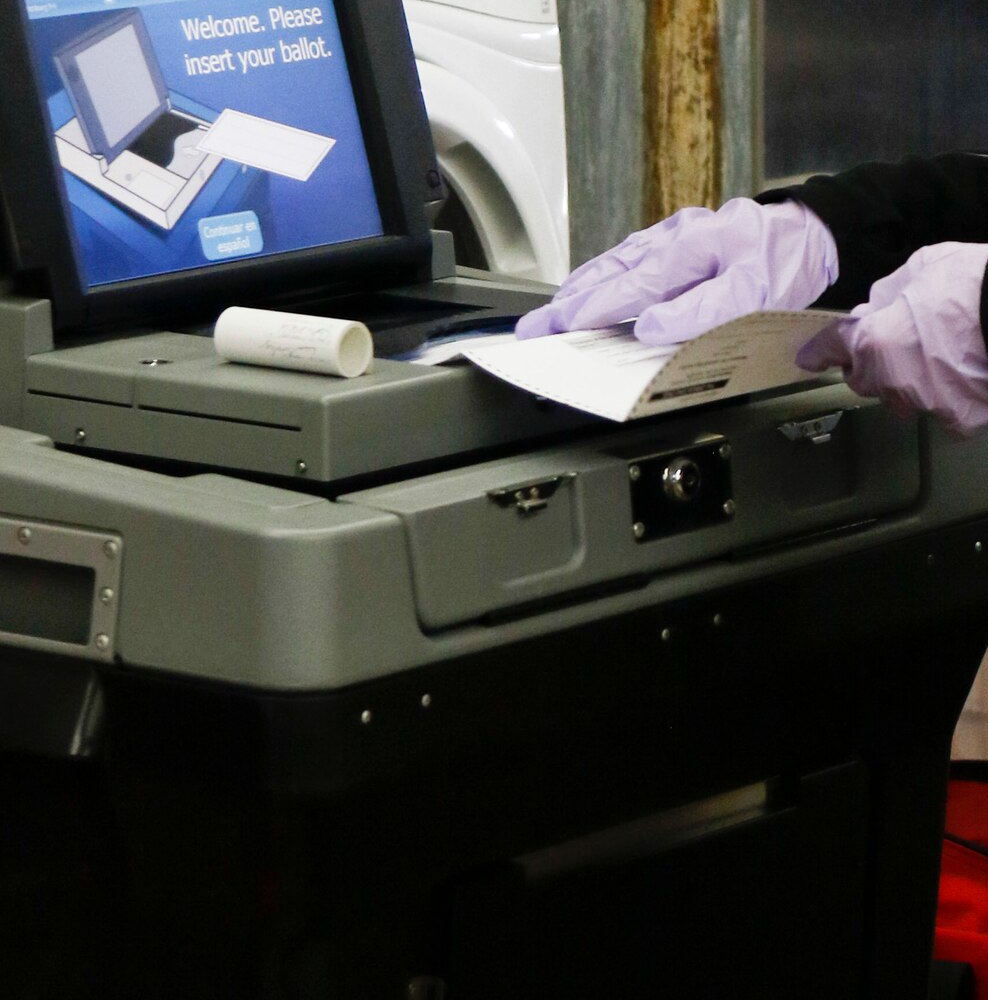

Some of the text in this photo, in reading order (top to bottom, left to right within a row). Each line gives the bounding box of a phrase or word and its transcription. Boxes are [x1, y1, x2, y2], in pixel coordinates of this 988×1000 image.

[181, 6, 323, 41] Welcome. Please
[184, 36, 332, 76] insert your ballot.
[204, 222, 256, 239] Continuar en
[218, 236, 250, 253] español
